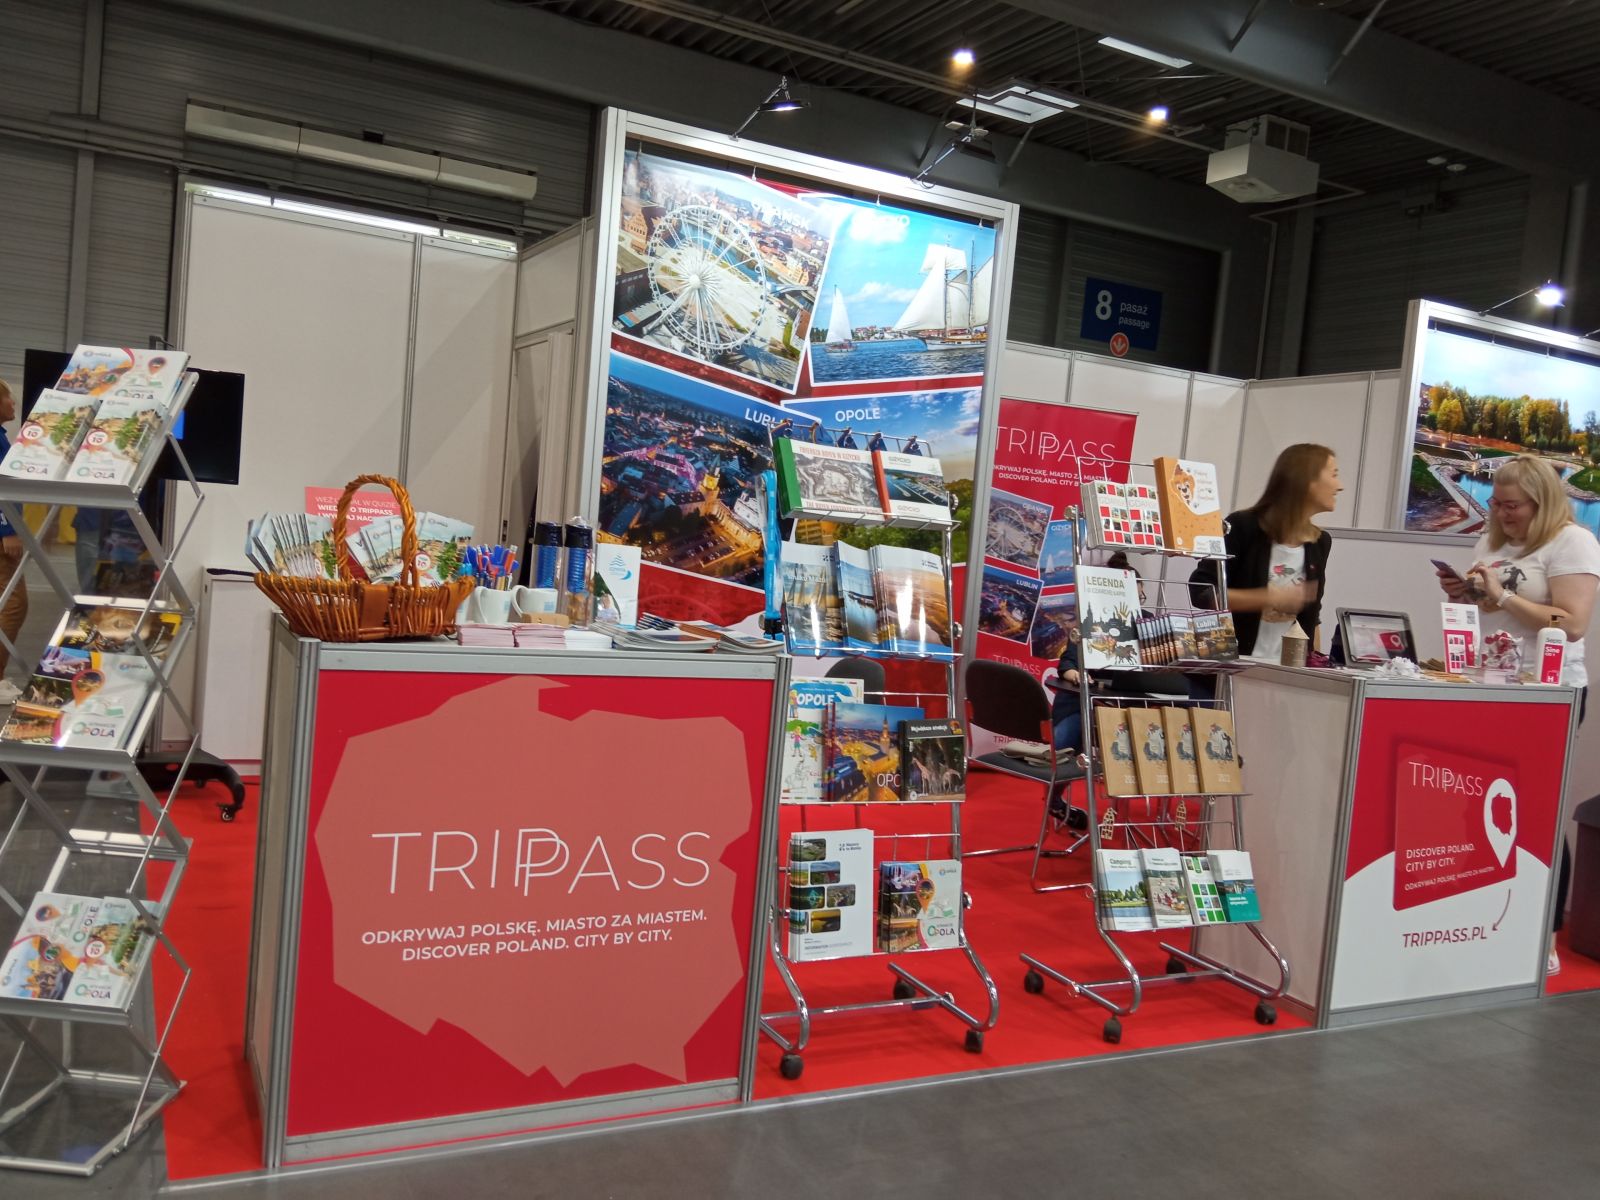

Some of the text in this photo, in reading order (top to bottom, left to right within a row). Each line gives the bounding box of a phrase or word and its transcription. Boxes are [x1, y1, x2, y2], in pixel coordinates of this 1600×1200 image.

[1095, 289, 1113, 321] 8
[1120, 303, 1148, 315] pasaż
[1119, 316, 1150, 329] passage
[834, 407, 881, 423] OPOLE
[998, 472, 1030, 481] DISCOVER
[1049, 470, 1073, 479] MIASTO
[1016, 579, 1038, 590] LUBLIN
[1086, 575, 1125, 589] LEGENDA
[796, 692, 835, 707] OPOLE
[1408, 761, 1484, 797] TRIPPASS
[1406, 846, 1446, 859] DISCOVER
[372, 828, 711, 896] TRIPPASS
[1405, 860, 1424, 873] CITY
[1426, 859, 1437, 869] BY
[361, 909, 707, 945] ODKRYWAJ POLSKĘ. MIASTO ZA MIASTEM.
[1402, 926, 1488, 948] TRIPPASS.PL
[402, 929, 673, 961] DISCOVER POLAND. CITY BY CITY.
